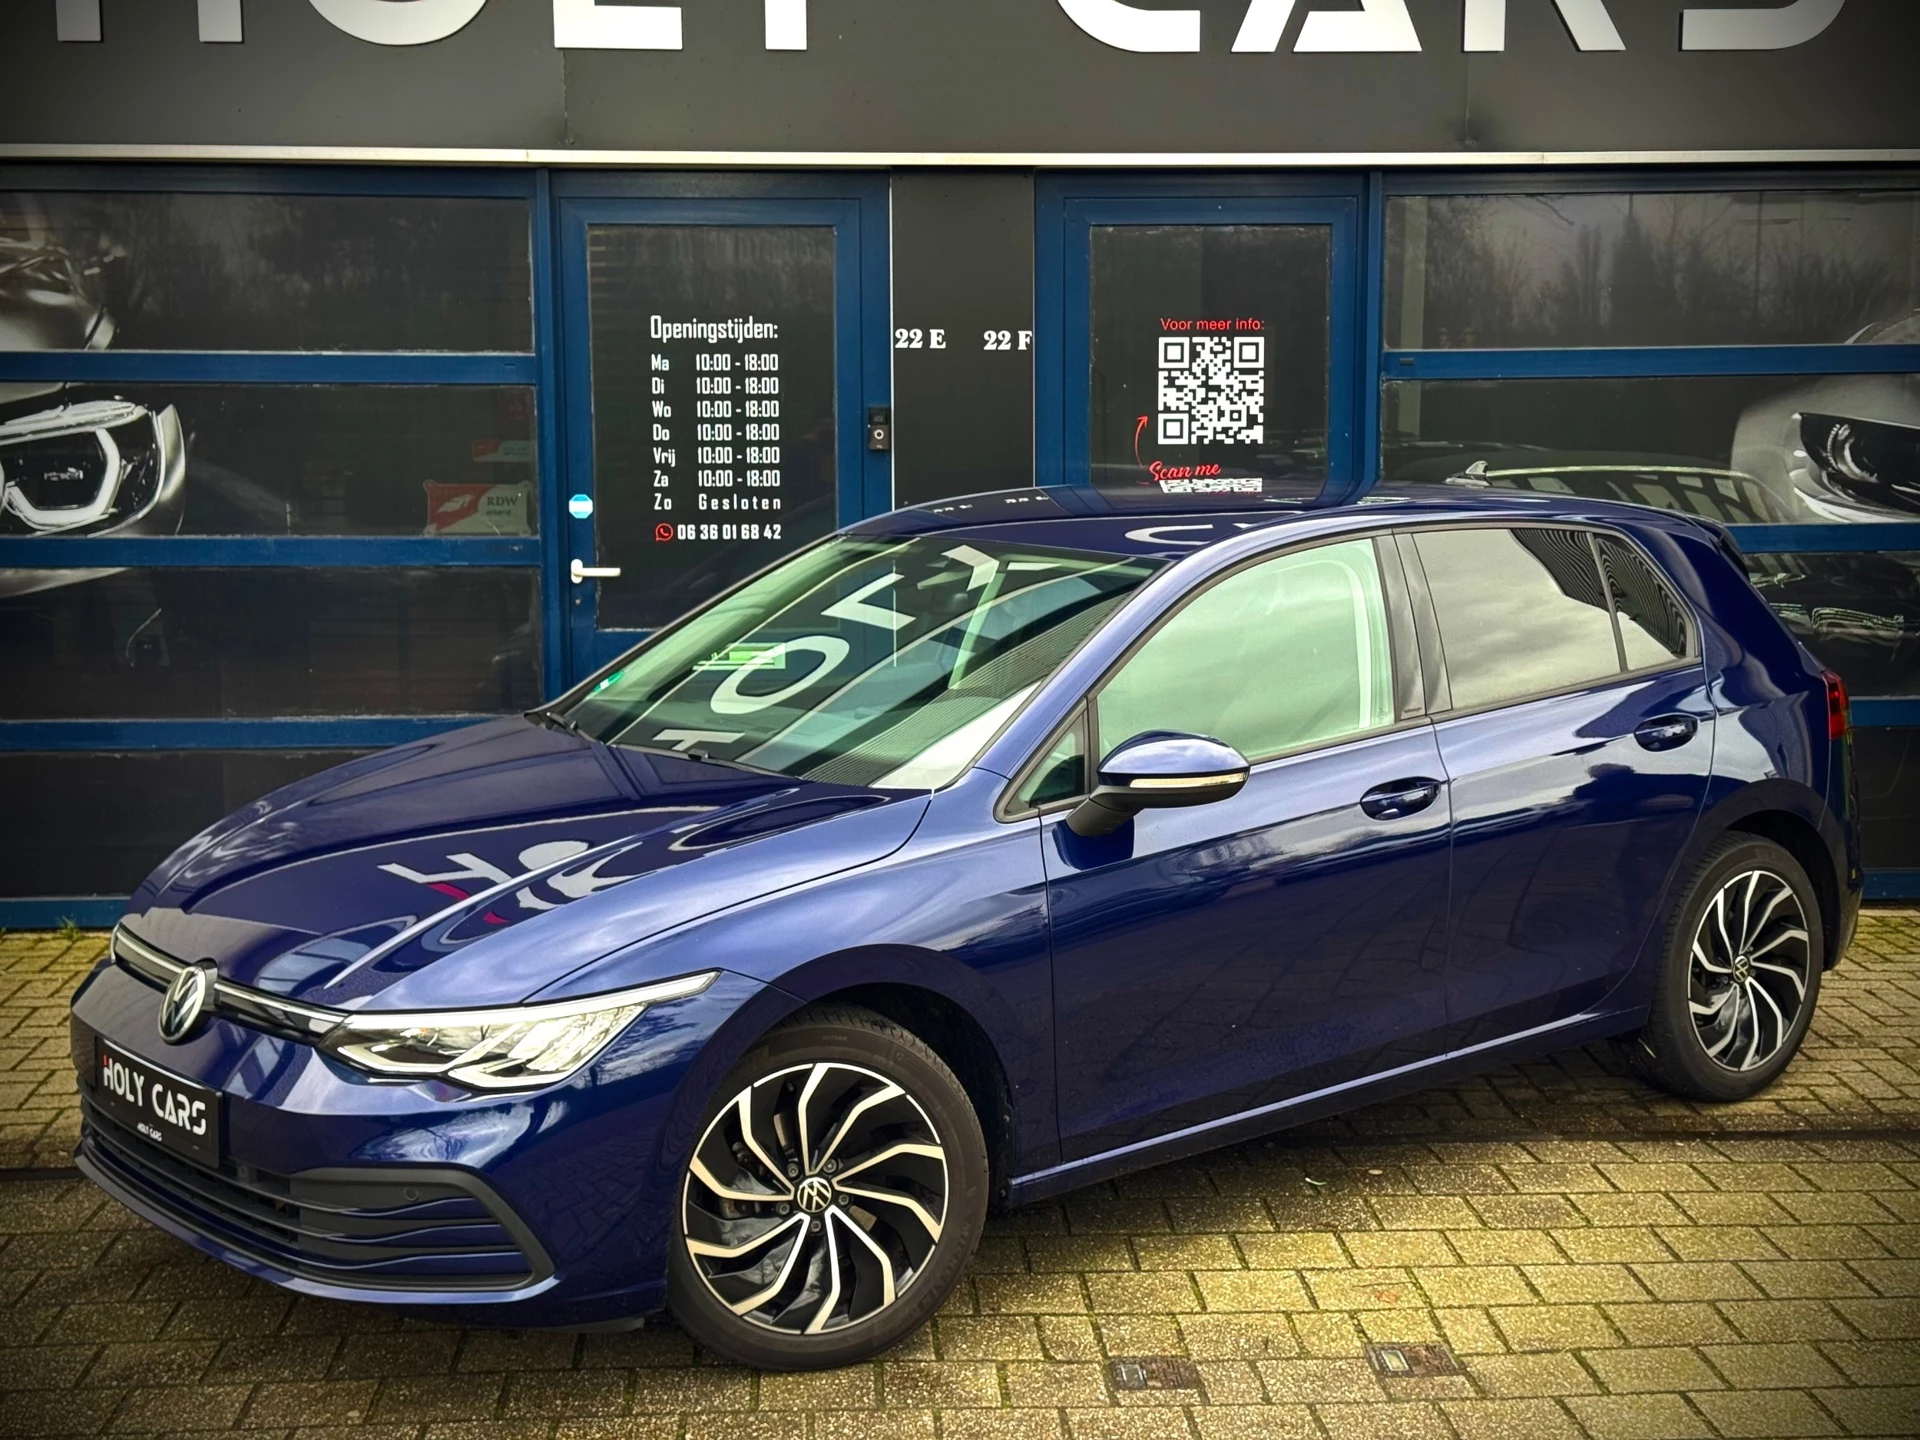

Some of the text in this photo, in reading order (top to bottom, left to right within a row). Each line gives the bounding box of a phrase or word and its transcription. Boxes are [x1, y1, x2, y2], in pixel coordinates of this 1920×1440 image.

[650, 315, 779, 344] Openingstijden:
[1161, 318, 1265, 331] Voor meer info:
[895, 328, 946, 349] 22 E
[983, 330, 1033, 351] 22 F
[651, 354, 670, 371] Ma
[696, 354, 731, 371] 10:00
[744, 354, 779, 371] 18:00
[652, 377, 665, 394] Di
[696, 377, 731, 394] 10:00
[744, 377, 779, 394] 18:00
[652, 400, 672, 418] Wo
[697, 400, 732, 417] 10:00
[745, 400, 779, 417] 18:00
[653, 424, 670, 441] Do
[697, 424, 732, 441] 10:00
[745, 424, 779, 441] 18:00
[653, 447, 676, 467] Vrij
[698, 447, 733, 464] 10:00
[746, 447, 780, 464] 18:00
[654, 470, 669, 487] Za
[698, 470, 733, 487] 10:00
[746, 470, 780, 487] 18:00
[1148, 460, 1222, 481] Scan me
[487, 496, 517, 506] RDW
[654, 493, 781, 510] Zo Gesloten
[677, 524, 696, 540] 06
[700, 524, 719, 540] 36
[723, 524, 737, 540] 01
[764, 524, 782, 540] 42
[103, 1054, 207, 1136] HOLY CARS
